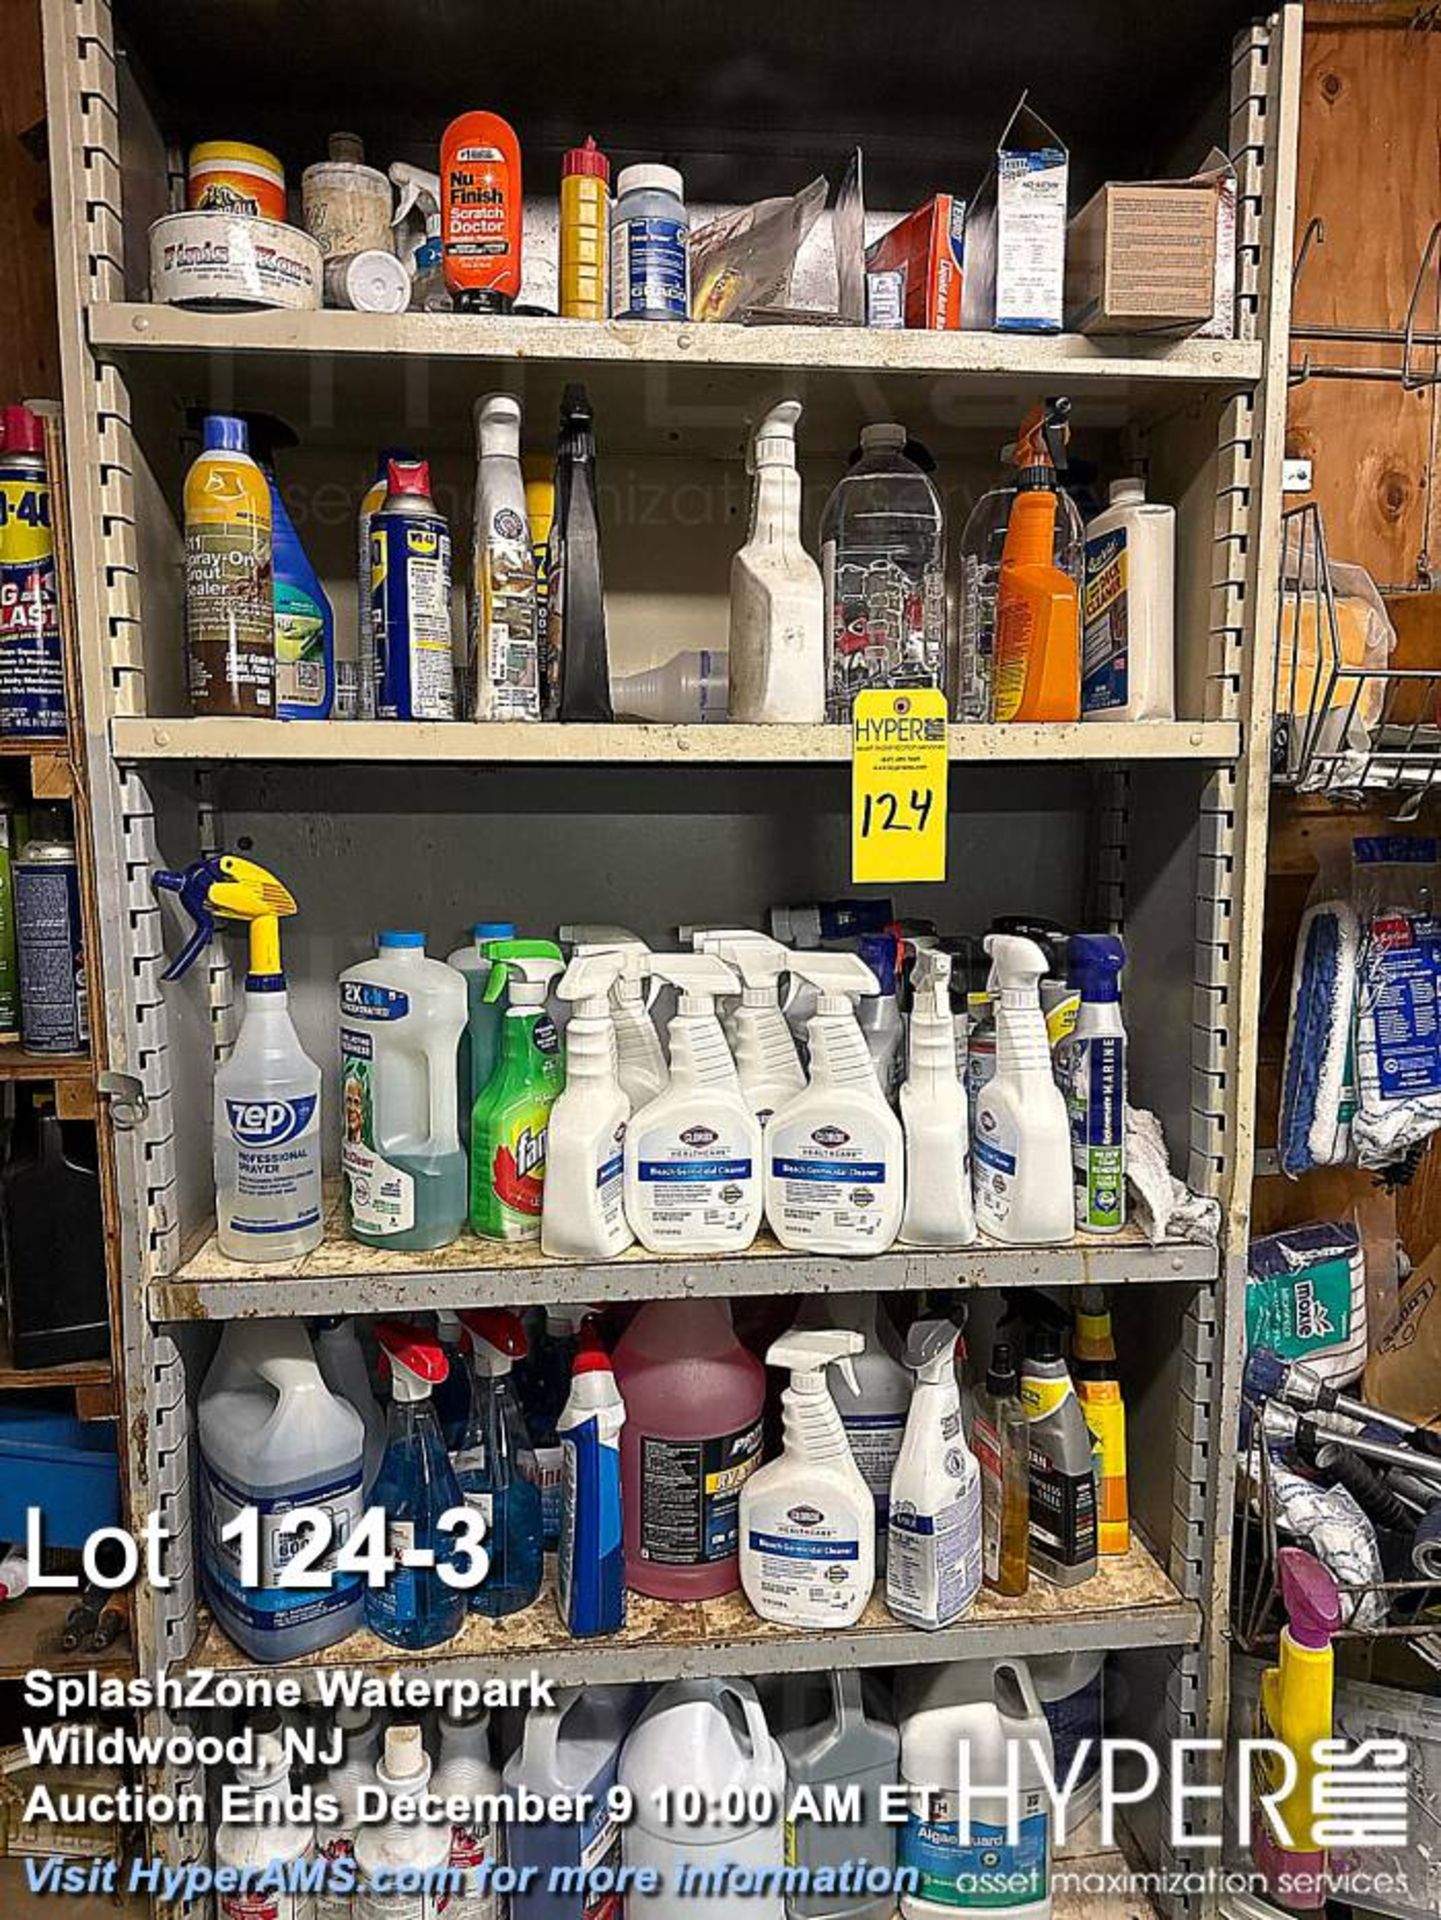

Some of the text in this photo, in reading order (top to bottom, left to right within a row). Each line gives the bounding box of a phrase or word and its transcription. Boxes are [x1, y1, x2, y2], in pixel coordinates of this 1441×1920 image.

[450, 171, 474, 187] Nu
[450, 187, 503, 204] Finish
[450, 206, 504, 219] Scratch
[450, 220, 504, 234] Doctor
[164, 242, 229, 271] Finis
[187, 550, 255, 569] pray-On
[187, 566, 221, 581] rout
[187, 582, 228, 596] ealer
[856, 718, 923, 741] HYPER
[861, 788, 934, 838] 124
[344, 983, 363, 1005] 2X
[1102, 1038, 1115, 1095] MARINE
[1296, 1284, 1313, 1336] moxie
